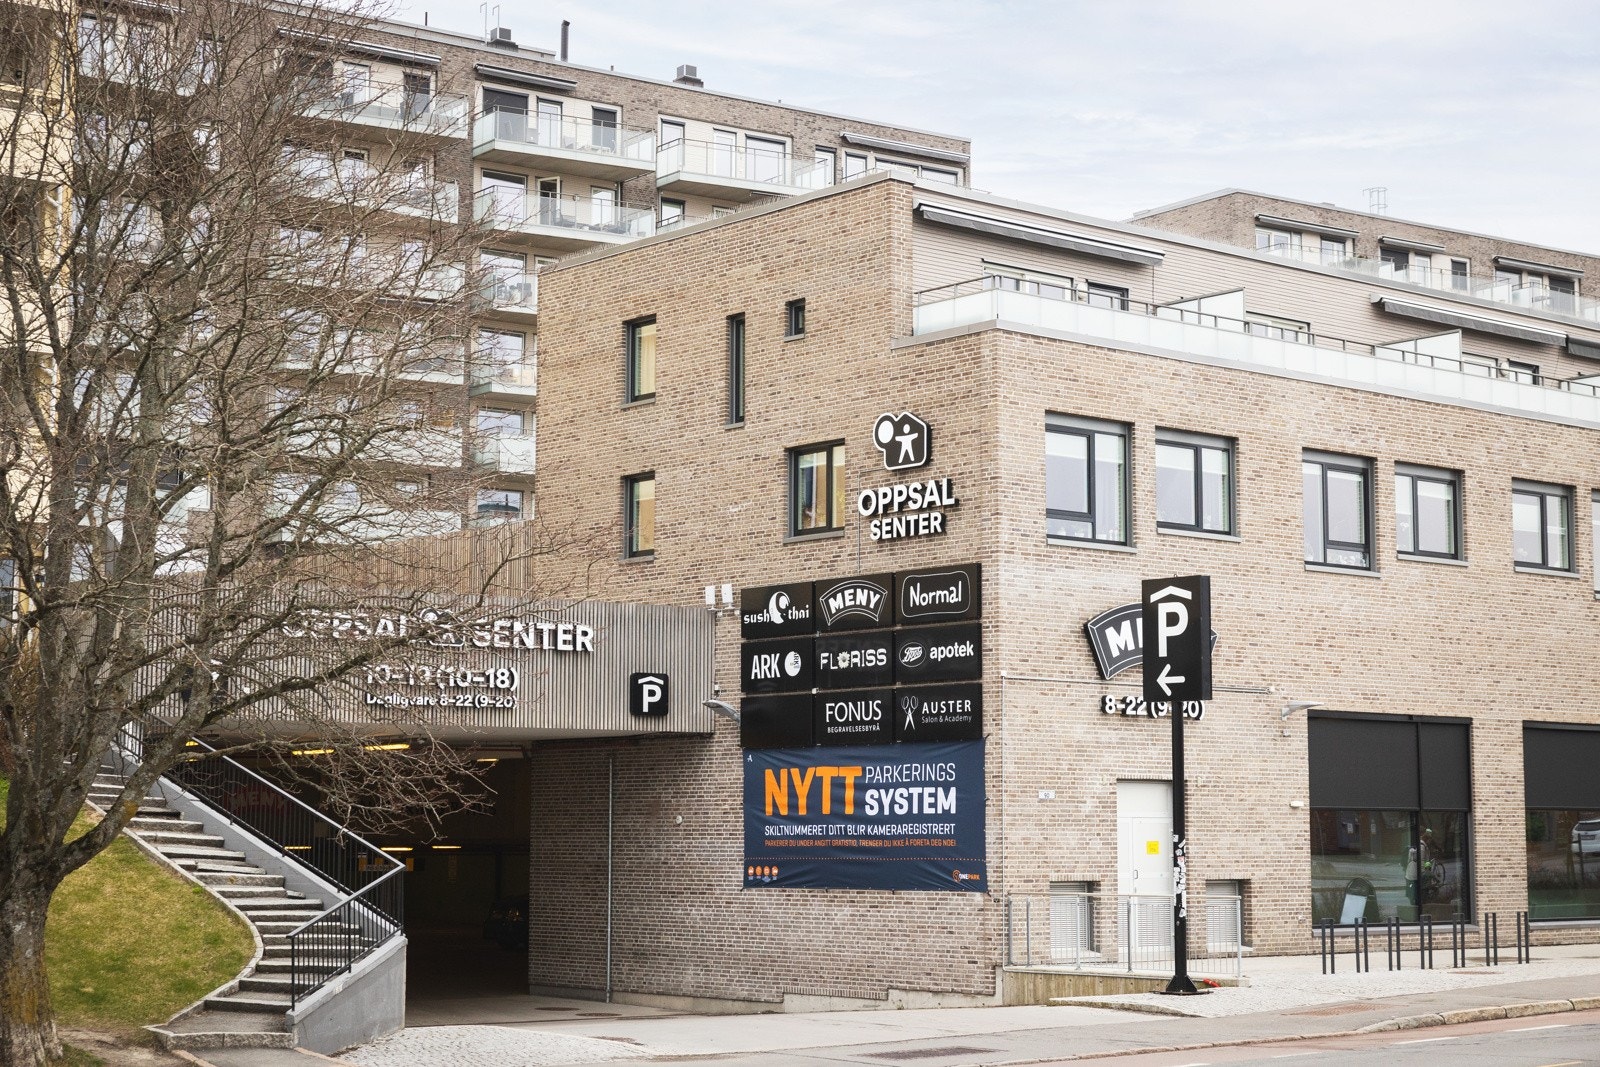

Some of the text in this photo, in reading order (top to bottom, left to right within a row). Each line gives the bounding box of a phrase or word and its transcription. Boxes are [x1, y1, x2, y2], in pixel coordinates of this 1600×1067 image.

[858, 478, 955, 516] OPPSAL
[870, 512, 942, 541] SENTER
[828, 588, 881, 614] MENY
[909, 581, 962, 608] Normal
[788, 604, 809, 620] thai
[472, 618, 594, 652] SENTER
[1157, 601, 1189, 658] P
[820, 648, 887, 670] FLORISS
[929, 640, 974, 661] apotek
[751, 653, 781, 680] ARK
[642, 684, 662, 713] P
[921, 700, 972, 714] AUSTER
[825, 700, 882, 723] FONUS
[921, 715, 938, 724] Salon
[944, 714, 972, 723] Academy
[827, 723, 881, 734] BEGRAVELSESBYRÅ
[865, 763, 956, 784] PARKERINGS
[764, 766, 863, 816] NYTT
[864, 787, 957, 816] SYSTEM
[764, 823, 956, 836] SKILTNUMMERET DITT BLIR KAMERAREGISTRERT
[859, 839, 882, 847] TRENGER
